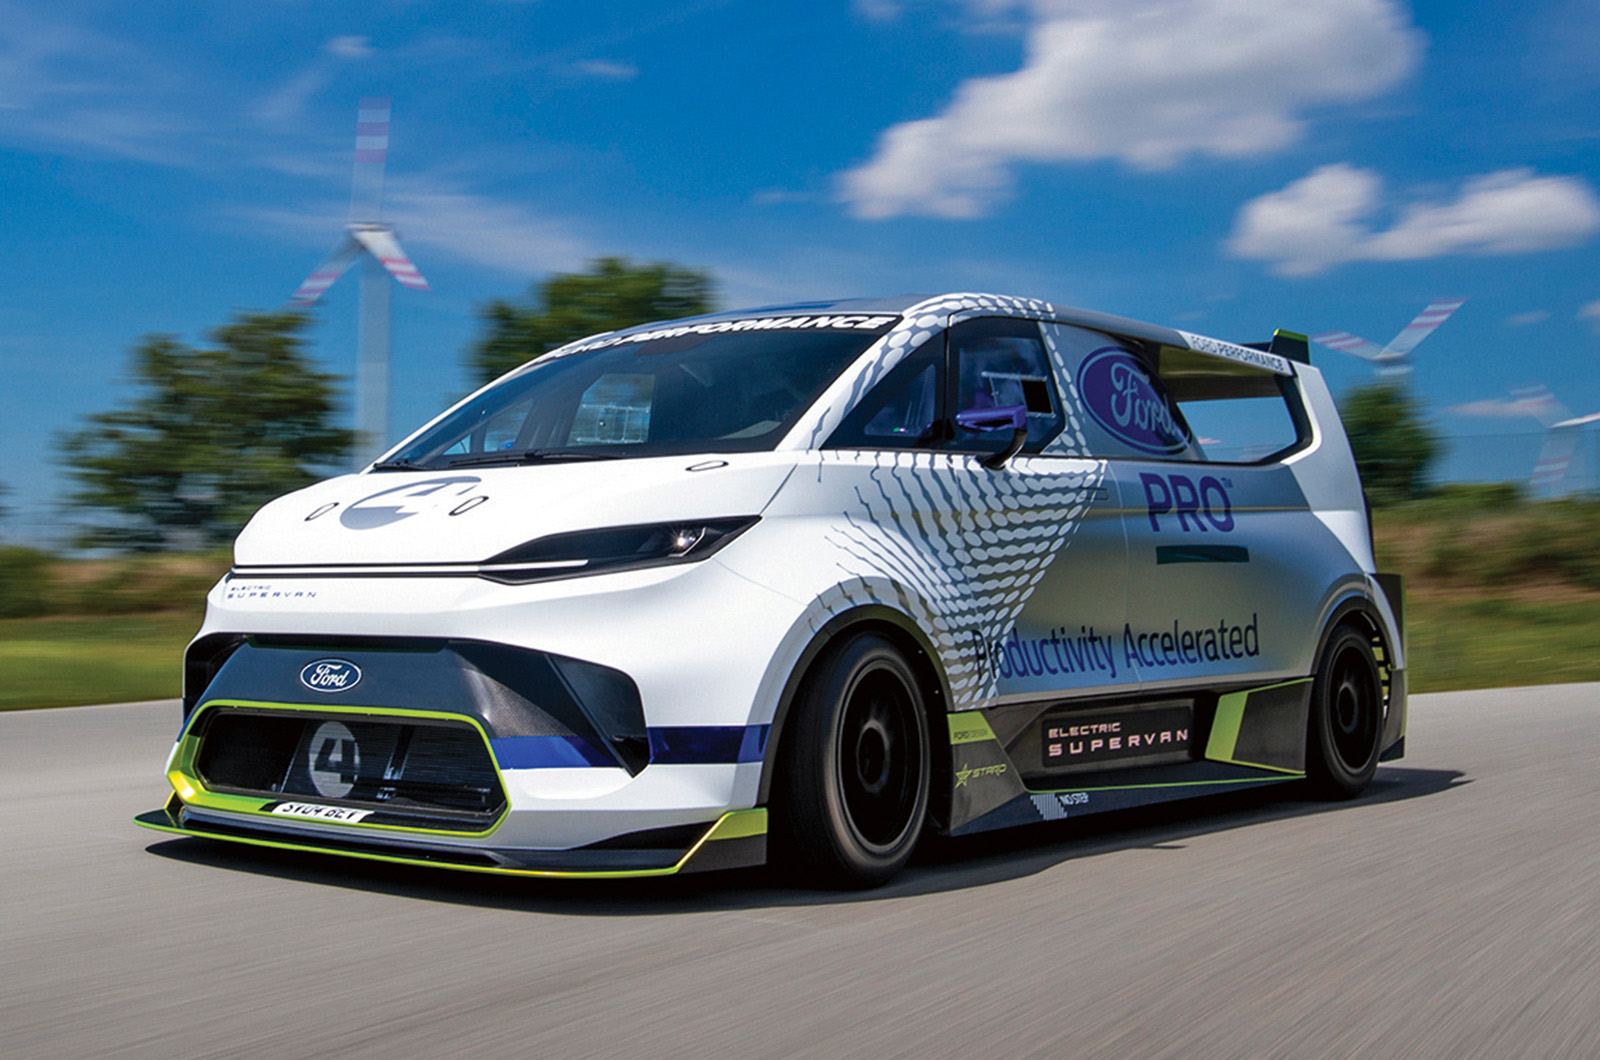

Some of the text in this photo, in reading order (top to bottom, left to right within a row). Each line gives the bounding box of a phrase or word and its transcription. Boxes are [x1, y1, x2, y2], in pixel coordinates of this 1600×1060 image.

[613, 316, 897, 346] PERFORMANCE
[1191, 335, 1285, 371] FORD PERFORMANCE
[1111, 362, 1176, 436] Ford
[1139, 472, 1234, 532] PRO
[972, 613, 1260, 679] Productivity Accelerated
[310, 663, 350, 687] Ford
[1048, 722, 1121, 739] ELECTRIC
[1048, 729, 1188, 757] SUPERVAN
